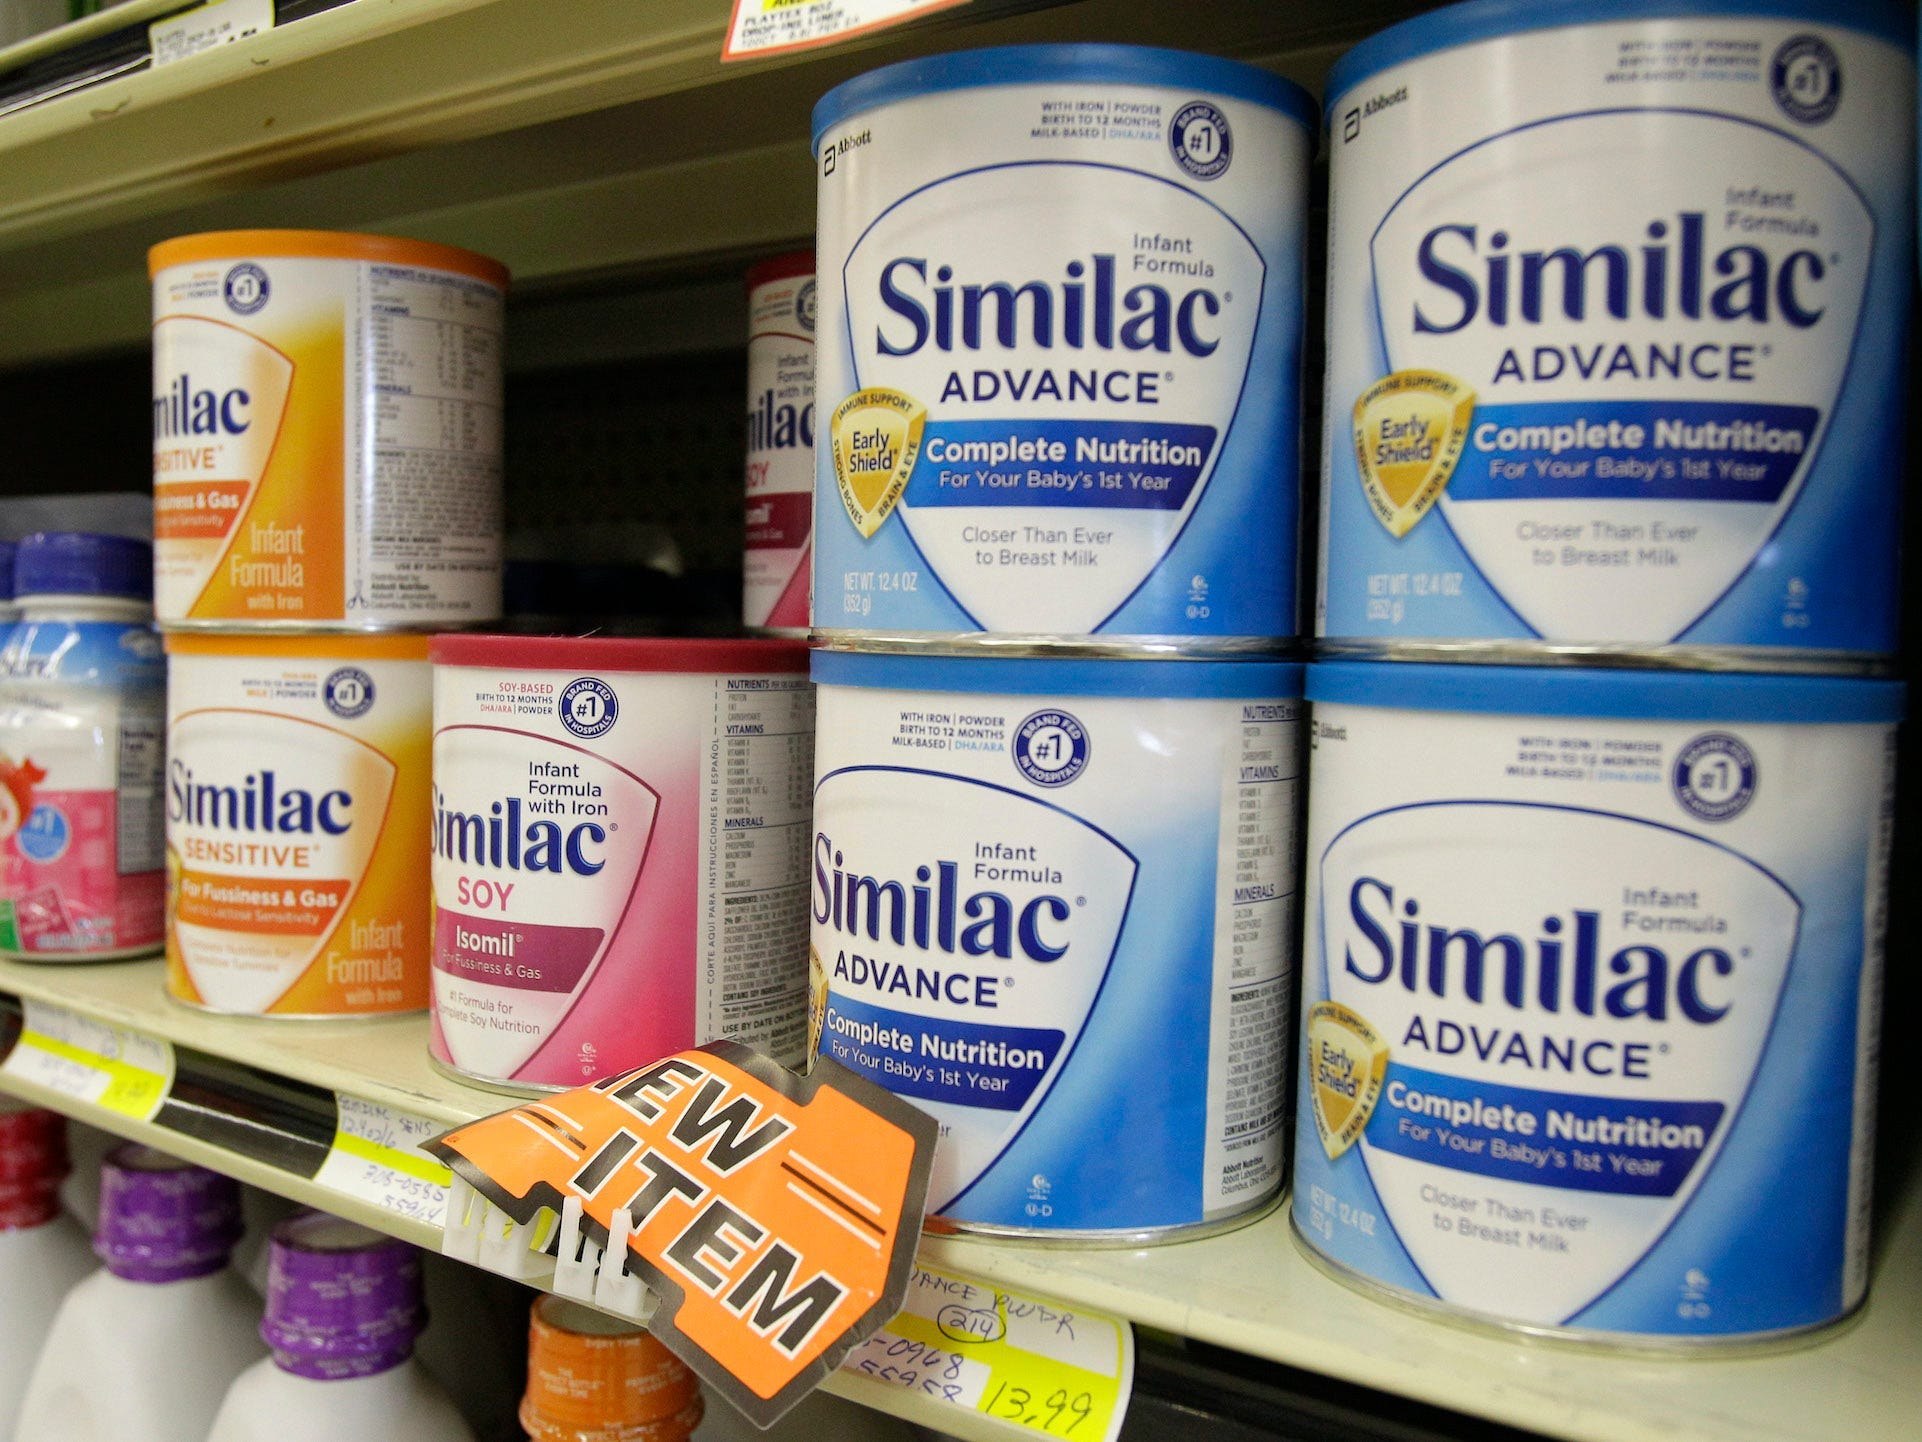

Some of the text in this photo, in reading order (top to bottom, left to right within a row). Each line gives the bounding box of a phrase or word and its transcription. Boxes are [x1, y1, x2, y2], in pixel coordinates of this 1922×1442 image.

[1041, 102, 1161, 115] WITH IRON POWDER
[1041, 115, 1161, 128] BIRTH TO MONTHS
[838, 128, 872, 156] Abbott
[1031, 128, 1100, 139] MILK-BASED
[1190, 126, 1212, 153] #1
[1727, 185, 1795, 211] Infant
[1726, 211, 1819, 237] Formula
[1133, 233, 1192, 254] Infant
[1133, 255, 1215, 278] Formula
[1412, 210, 1826, 334] Similac
[876, 252, 1222, 358] Similac
[1492, 344, 1756, 385] ADVANCE
[940, 370, 1160, 404] ADVANCE
[838, 392, 913, 421] IMMUNE SUPPORT
[853, 428, 890, 451] Early
[1380, 414, 1430, 445] Early
[1473, 418, 1804, 455] Complete Nutrition
[849, 451, 893, 473] Shield
[926, 435, 1202, 467] Complete Nutrition
[1376, 441, 1433, 465] Shield
[878, 440, 919, 518] BRAIN EYE
[939, 470, 1172, 491] For Your Baby's 1st Year
[1488, 457, 1769, 483] For Your Baby's 1st Year
[208, 489, 240, 509] Gas
[251, 520, 305, 555] Infant
[962, 525, 1114, 545] Closer Than Ever
[1591, 521, 1700, 542] Than Ever
[976, 549, 1099, 567] to Breast Milk
[1532, 546, 1678, 567] to Breast Milk
[229, 555, 305, 588] Formula
[339, 683, 356, 701] #1
[499, 682, 554, 695] SOY-BASED
[565, 681, 611, 701] BRAND FED
[727, 679, 771, 690] NUTRIENTS
[475, 692, 554, 705] BIRTH TO 12 MONTHS
[480, 703, 554, 716] DHA/ARA POWDER
[576, 696, 596, 717] #1
[570, 714, 613, 735] HOSPITALS
[726, 724, 764, 734] VITAMINS
[899, 724, 1005, 740] BIRTH TO 12 MONTHS
[900, 711, 1005, 727] WITH IRON POWDER
[1022, 713, 1083, 741] BRAND FED
[892, 736, 1005, 752] MILK-BASED DHA/ARA
[1036, 733, 1062, 760] #1
[529, 761, 580, 778] Infant
[1027, 757, 1084, 784] HOSPITALS
[1240, 764, 1279, 780] VITAMINS
[167, 758, 353, 836] Similac
[528, 780, 602, 798] Formula
[529, 800, 608, 816] with Iron
[724, 816, 764, 829] MINERALS
[184, 836, 311, 869] SENSITIVE
[706, 738, 720, 985] CORTE PARA INSTRUCCIONES EN ESPAÑOL
[975, 842, 1037, 862] Infant
[974, 863, 1063, 884] Formula
[203, 881, 339, 908] Fussiness & Gas
[457, 876, 515, 912] SOY
[813, 831, 1071, 964] Similac
[1234, 883, 1275, 900] MINERALS
[1622, 887, 1698, 909] Infant
[352, 917, 404, 950] Infant
[1621, 910, 1728, 935] Formula
[456, 924, 515, 957] Isomil
[1345, 876, 1734, 1026] Similac
[326, 950, 404, 984] Formula
[455, 953, 542, 980] Fussiness & Gas
[834, 949, 999, 1009] ADVANCE
[459, 993, 514, 1015] Formula for
[469, 1012, 488, 1029] Soy
[489, 1016, 541, 1035] Nutrition
[722, 1017, 773, 1034] USE BY DATE
[826, 1007, 914, 1054] Complete
[920, 1032, 1045, 1071] Nutrition
[1402, 1014, 1651, 1079] ADVANCE
[832, 1039, 1010, 1093] For Your Baby's 1st Year
[1322, 1039, 1355, 1077] Early
[590, 1057, 797, 1179] EW
[1385, 1078, 1704, 1150] Complete Nutrition
[1398, 1117, 1665, 1178] For Your Baby's 1st Year
[1419, 1182, 1589, 1232] Closer Than Ever
[567, 1125, 850, 1361] ITEM
[1432, 1211, 1569, 1255] to Breast Milk
[949, 1310, 993, 1341] 214
